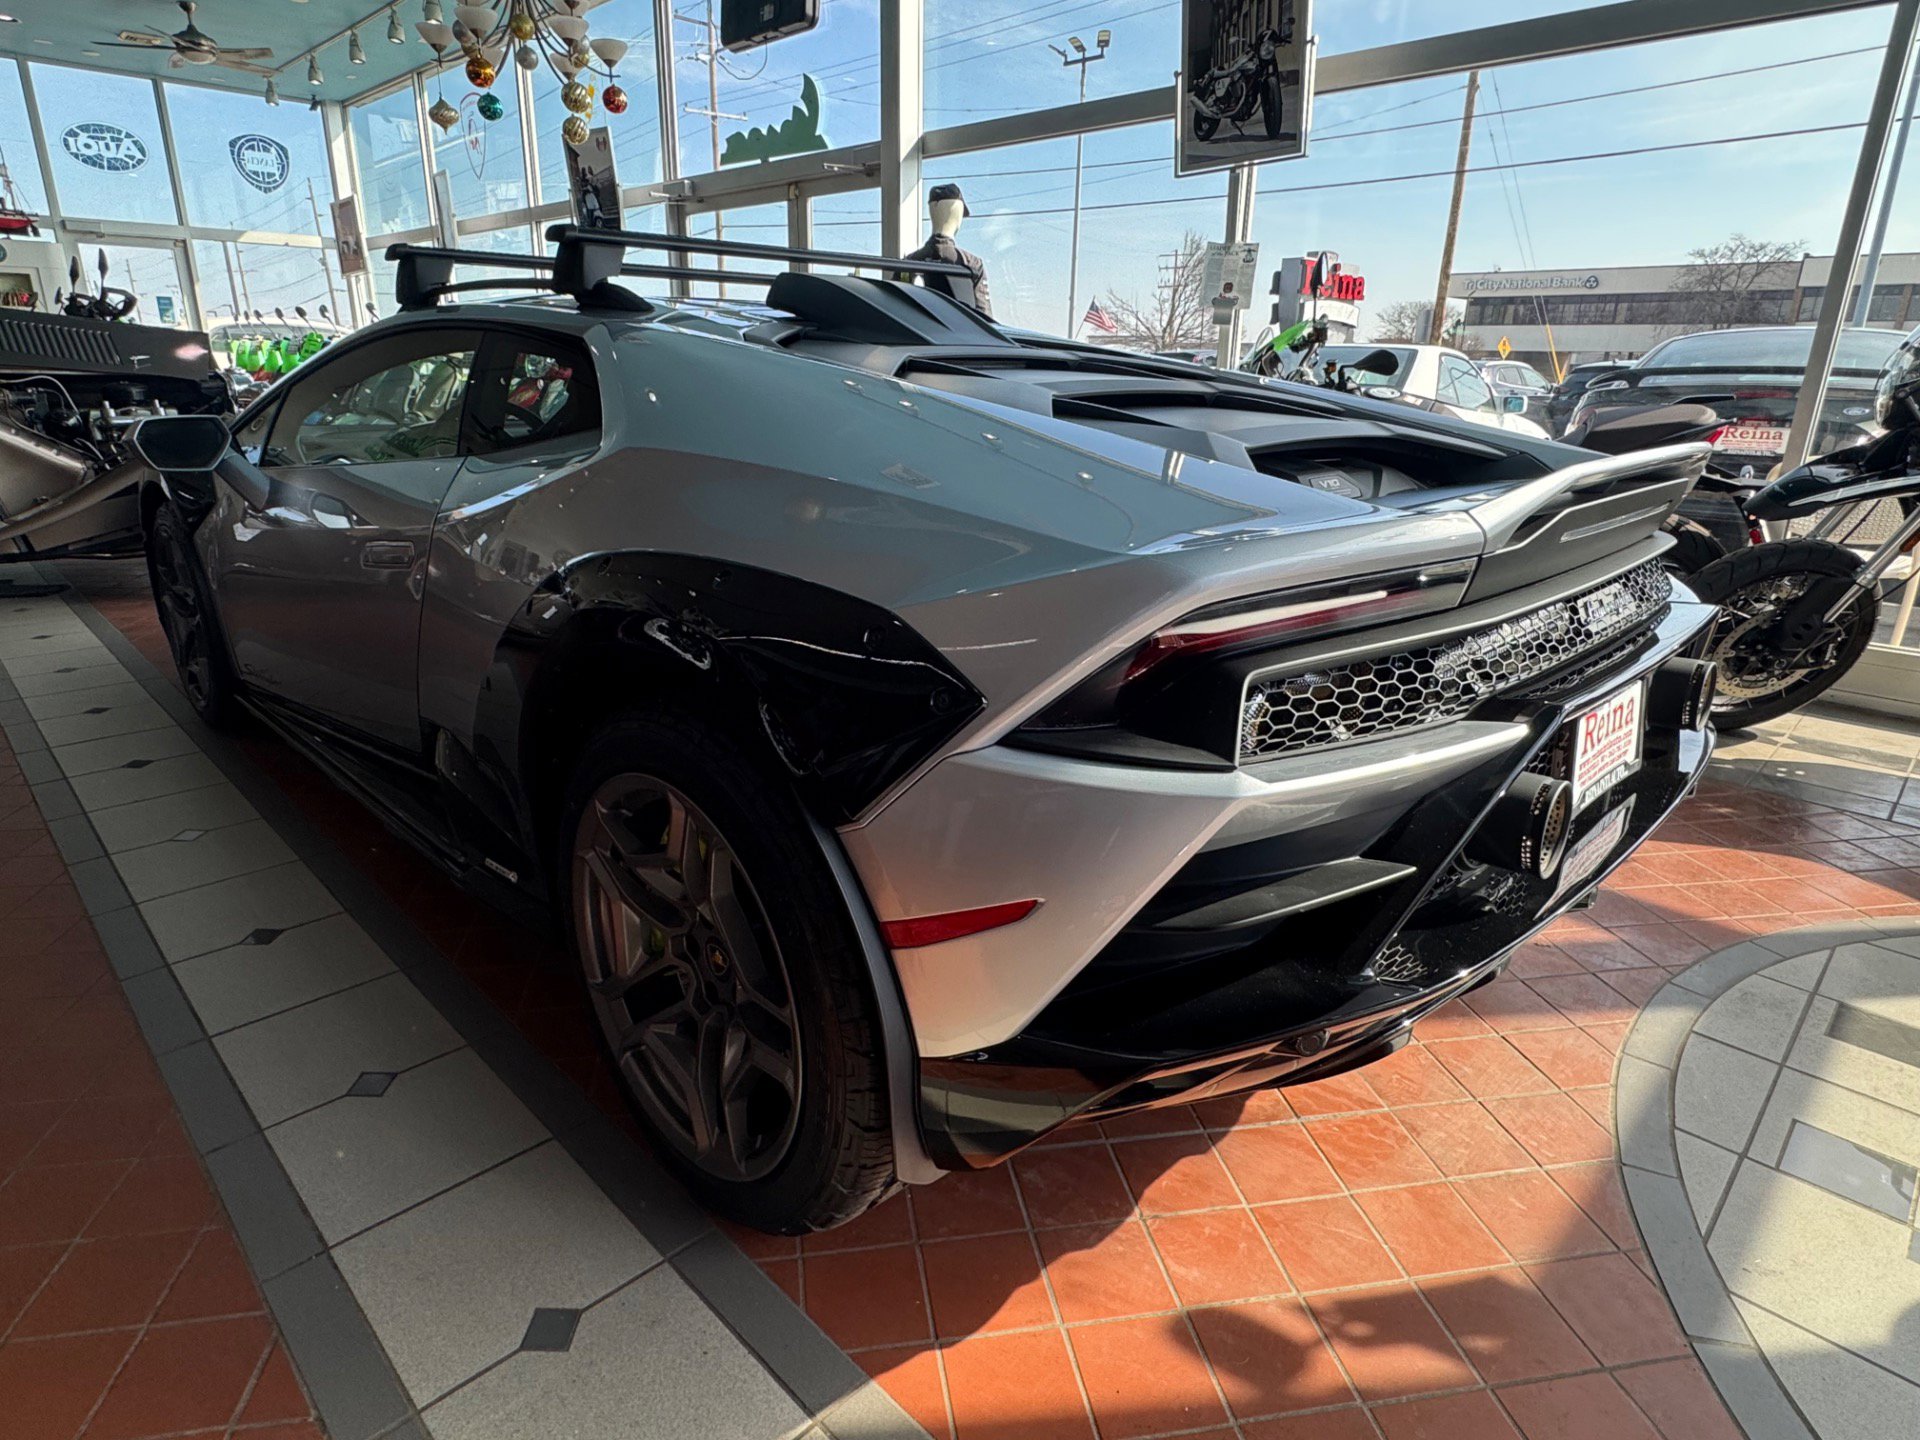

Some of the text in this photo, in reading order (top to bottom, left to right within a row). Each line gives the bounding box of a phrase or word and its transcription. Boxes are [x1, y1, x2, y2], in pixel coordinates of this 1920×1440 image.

[1501, 278, 1550, 290] National
[1552, 277, 1582, 288] Bank
[1723, 425, 1783, 441] Reina
[1319, 479, 1340, 488] V10
[1581, 697, 1635, 758] Reina
